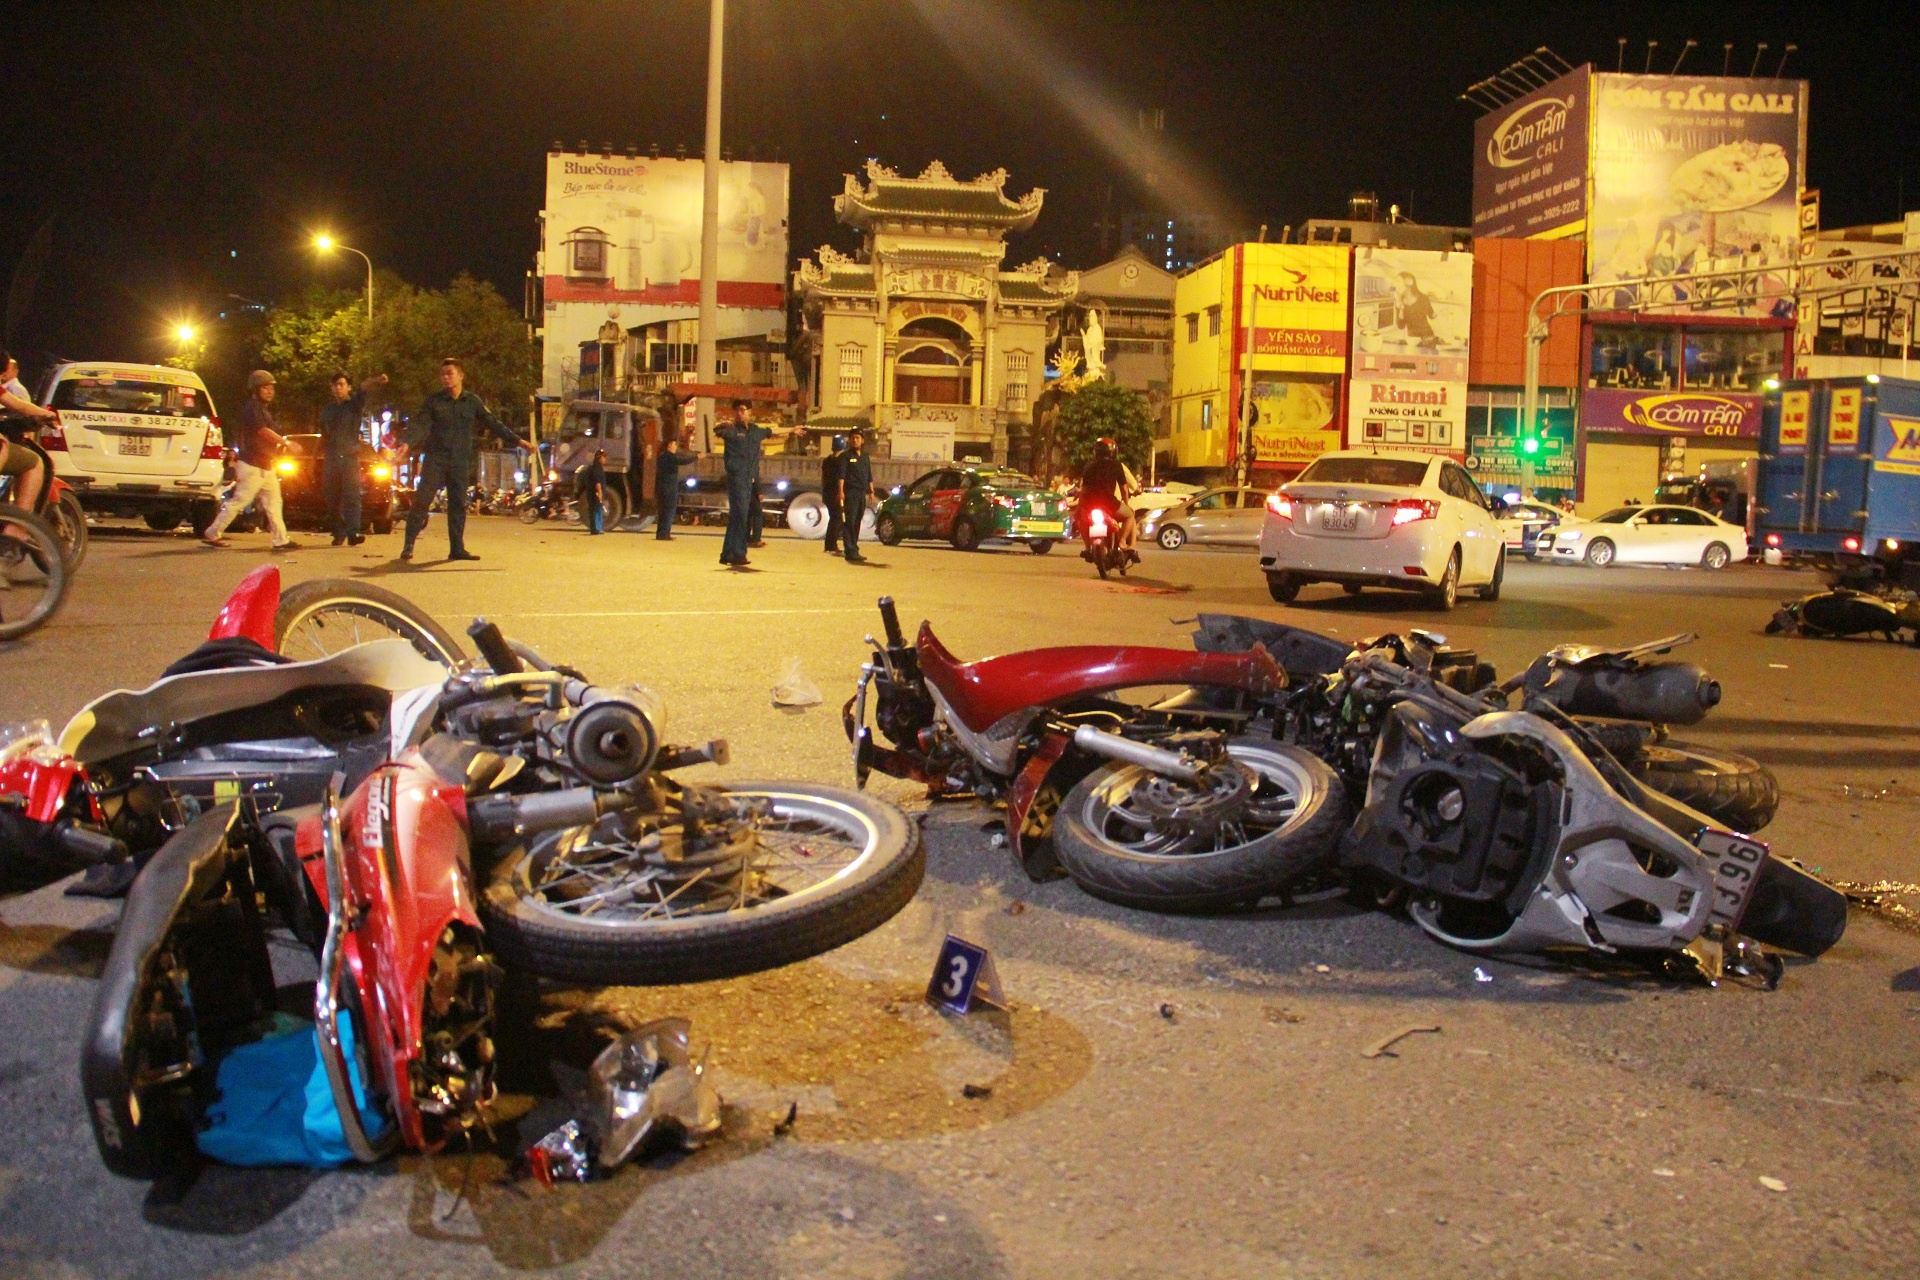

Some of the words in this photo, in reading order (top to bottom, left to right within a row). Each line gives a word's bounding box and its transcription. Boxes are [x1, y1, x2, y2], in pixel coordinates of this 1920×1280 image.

[1730, 92, 1794, 114] CALI
[1537, 137, 1564, 159] CALI
[564, 161, 634, 176] BlueStone
[1254, 284, 1339, 303] NutriNest
[1268, 330, 1293, 343] YẾN
[1296, 332, 1320, 344] SÀO
[1370, 384, 1447, 405] Rinnai
[1370, 407, 1398, 416] KHÔNG
[1402, 407, 1416, 416] CHỈ
[1419, 408, 1428, 417] LÀ
[1256, 435, 1326, 450] NutriNest
[942, 956, 968, 997] 3
